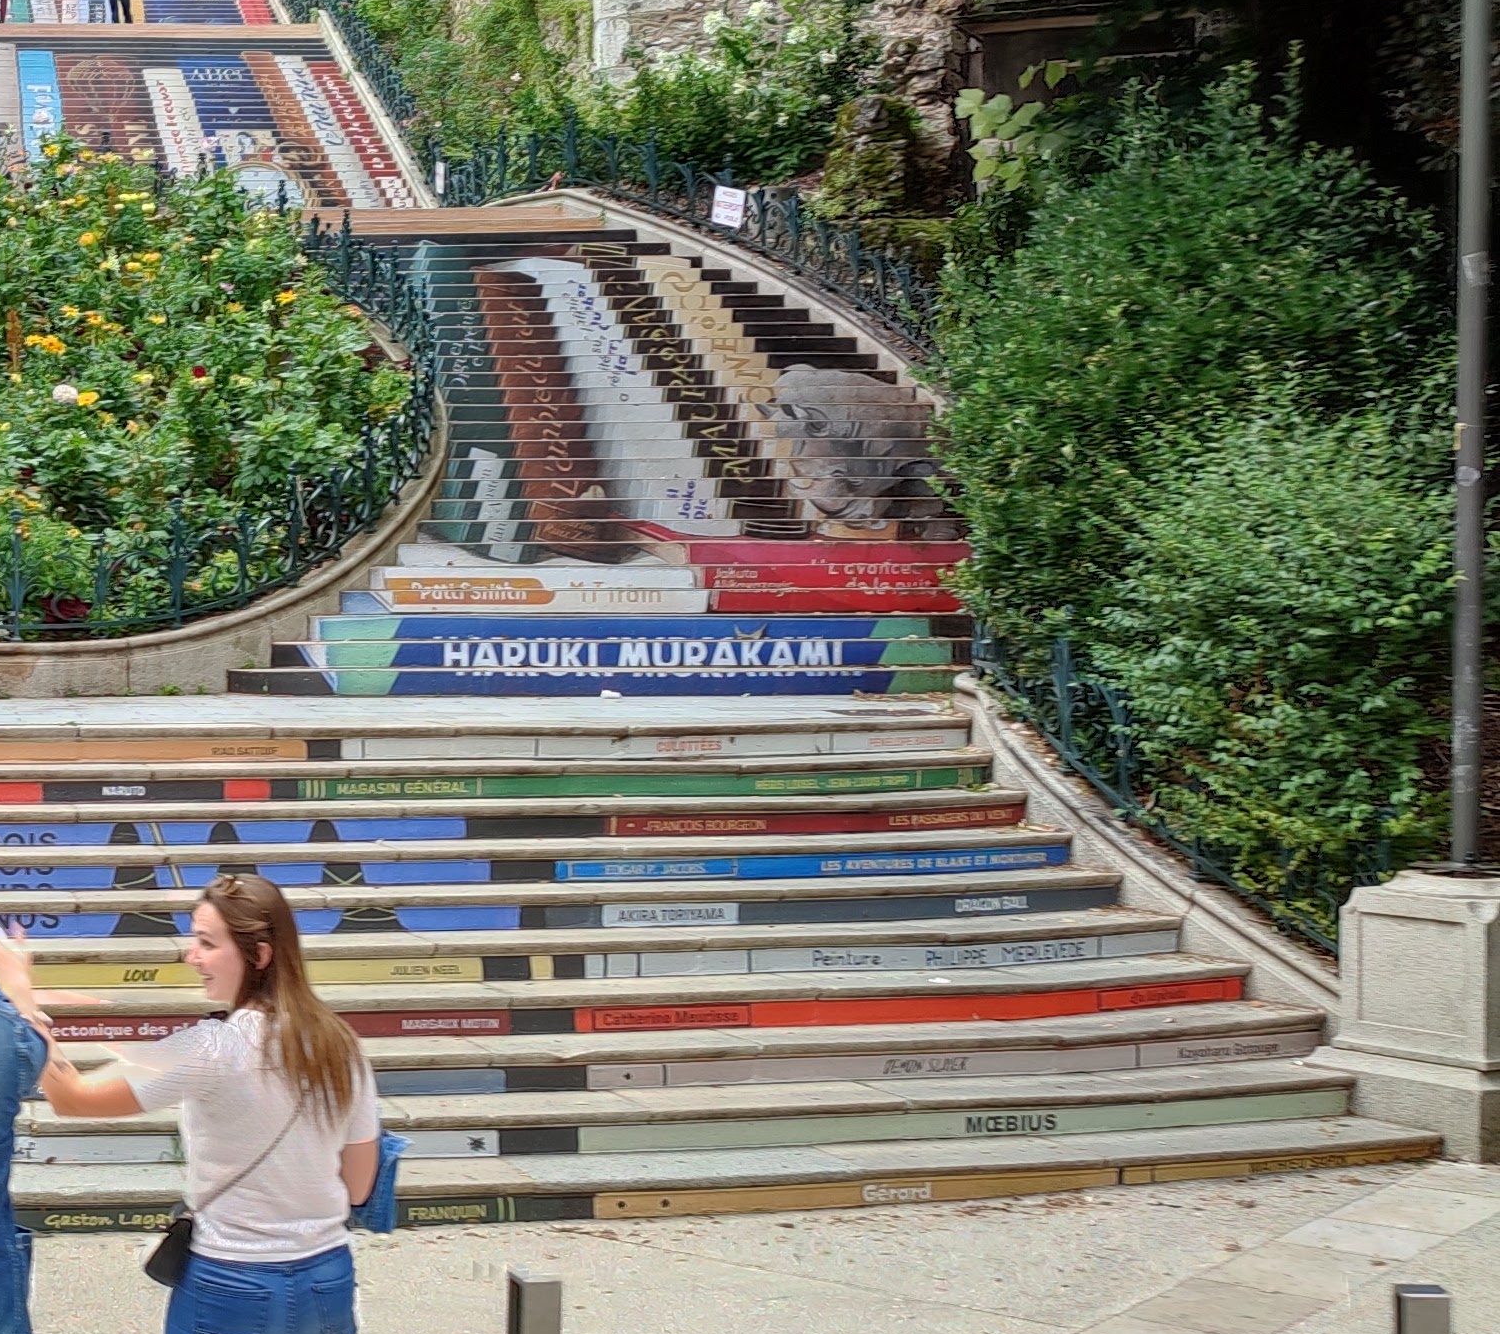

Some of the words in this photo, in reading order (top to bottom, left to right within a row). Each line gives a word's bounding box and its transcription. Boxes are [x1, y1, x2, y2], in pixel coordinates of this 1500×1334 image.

[442, 640, 600, 669] HARUKI
[617, 640, 844, 669] MURAKAMI
[336, 781, 401, 795] MAGASIN
[403, 779, 470, 794] GÉNÉRAL
[812, 950, 882, 968] Peinture
[602, 1011, 672, 1027] Catherine
[137, 1022, 168, 1037] des
[965, 1113, 1058, 1134] MŒBIUS
[861, 1181, 933, 1202] Gérard
[44, 1213, 115, 1229] Gaston
[118, 1212, 174, 1230] Laga
[407, 1204, 488, 1221] FRANQUIN
